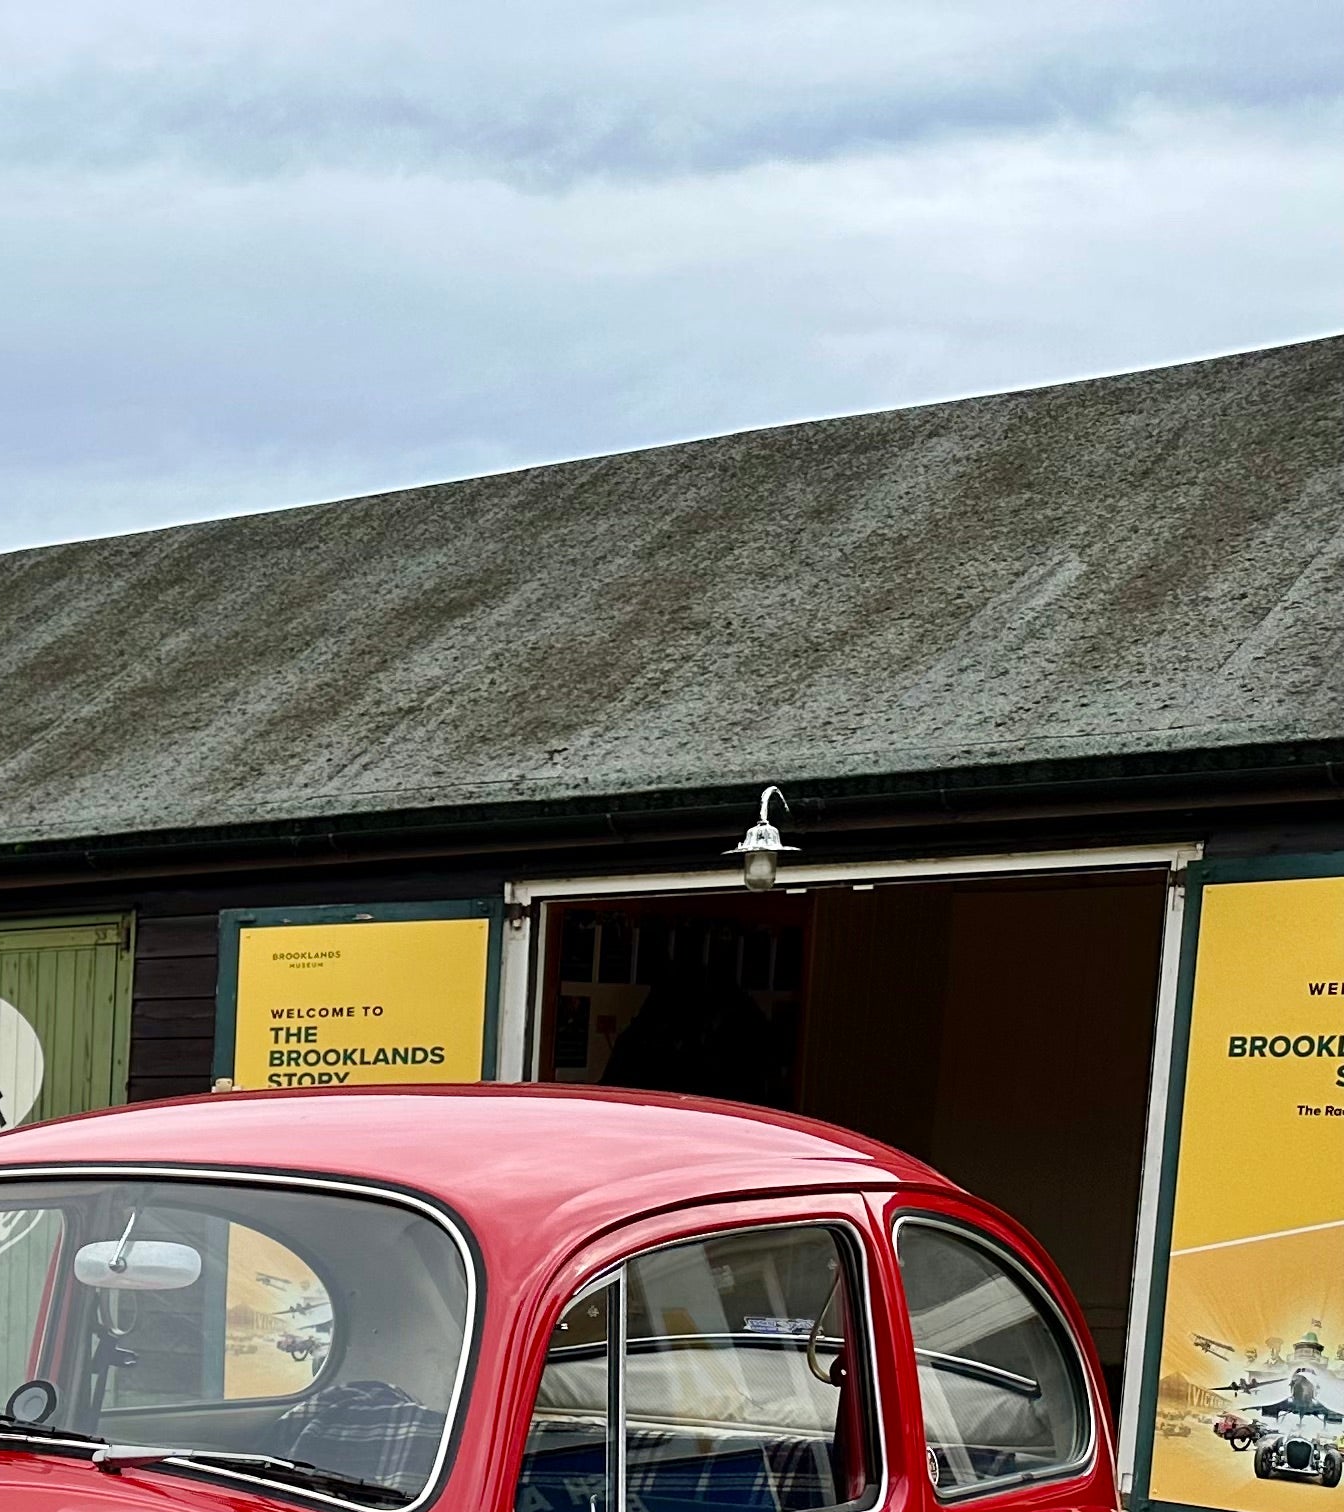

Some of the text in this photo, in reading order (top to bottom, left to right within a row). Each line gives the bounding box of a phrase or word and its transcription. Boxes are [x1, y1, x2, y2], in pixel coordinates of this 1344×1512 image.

[272, 950, 342, 961] BROOKLANDS
[270, 1006, 384, 1020] WELCOME TO
[269, 1026, 319, 1045] THE
[268, 1046, 446, 1067] BROOKLANDS
[1297, 1105, 1322, 1116] The
